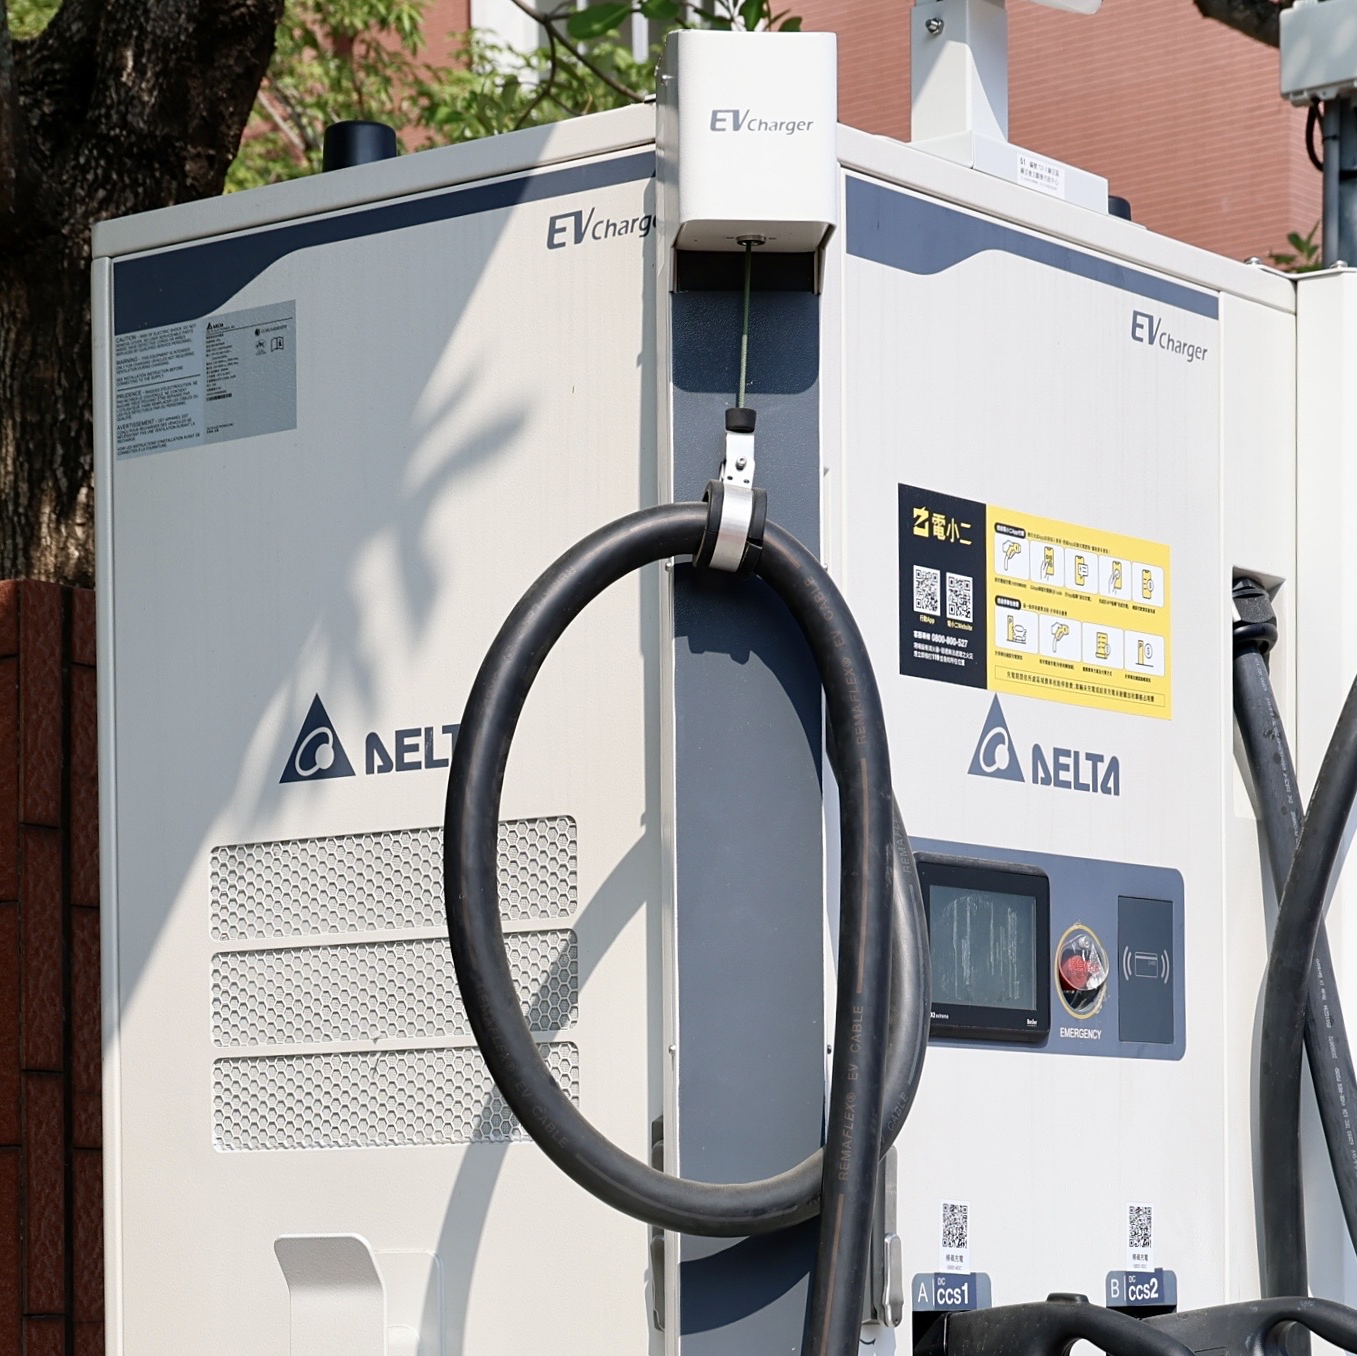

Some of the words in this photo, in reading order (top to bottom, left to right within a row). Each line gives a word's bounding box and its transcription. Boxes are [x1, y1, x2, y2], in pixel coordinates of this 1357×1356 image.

[747, 117, 814, 135] Charger
[1158, 332, 1208, 363] Charger
[931, 512, 972, 545] 電小二
[804, 575, 834, 622] CABLE
[830, 630, 845, 648] EV
[1031, 743, 1121, 796] DELTA
[849, 1005, 863, 1053] CABLE
[1060, 1027, 1102, 1040] EMERGENCY
[848, 1063, 859, 1080] EV
[532, 1105, 569, 1149] CABLE
[838, 1091, 856, 1181] REMAFLEX®
[917, 1283, 928, 1303] A
[1110, 1280, 1120, 1298] B
